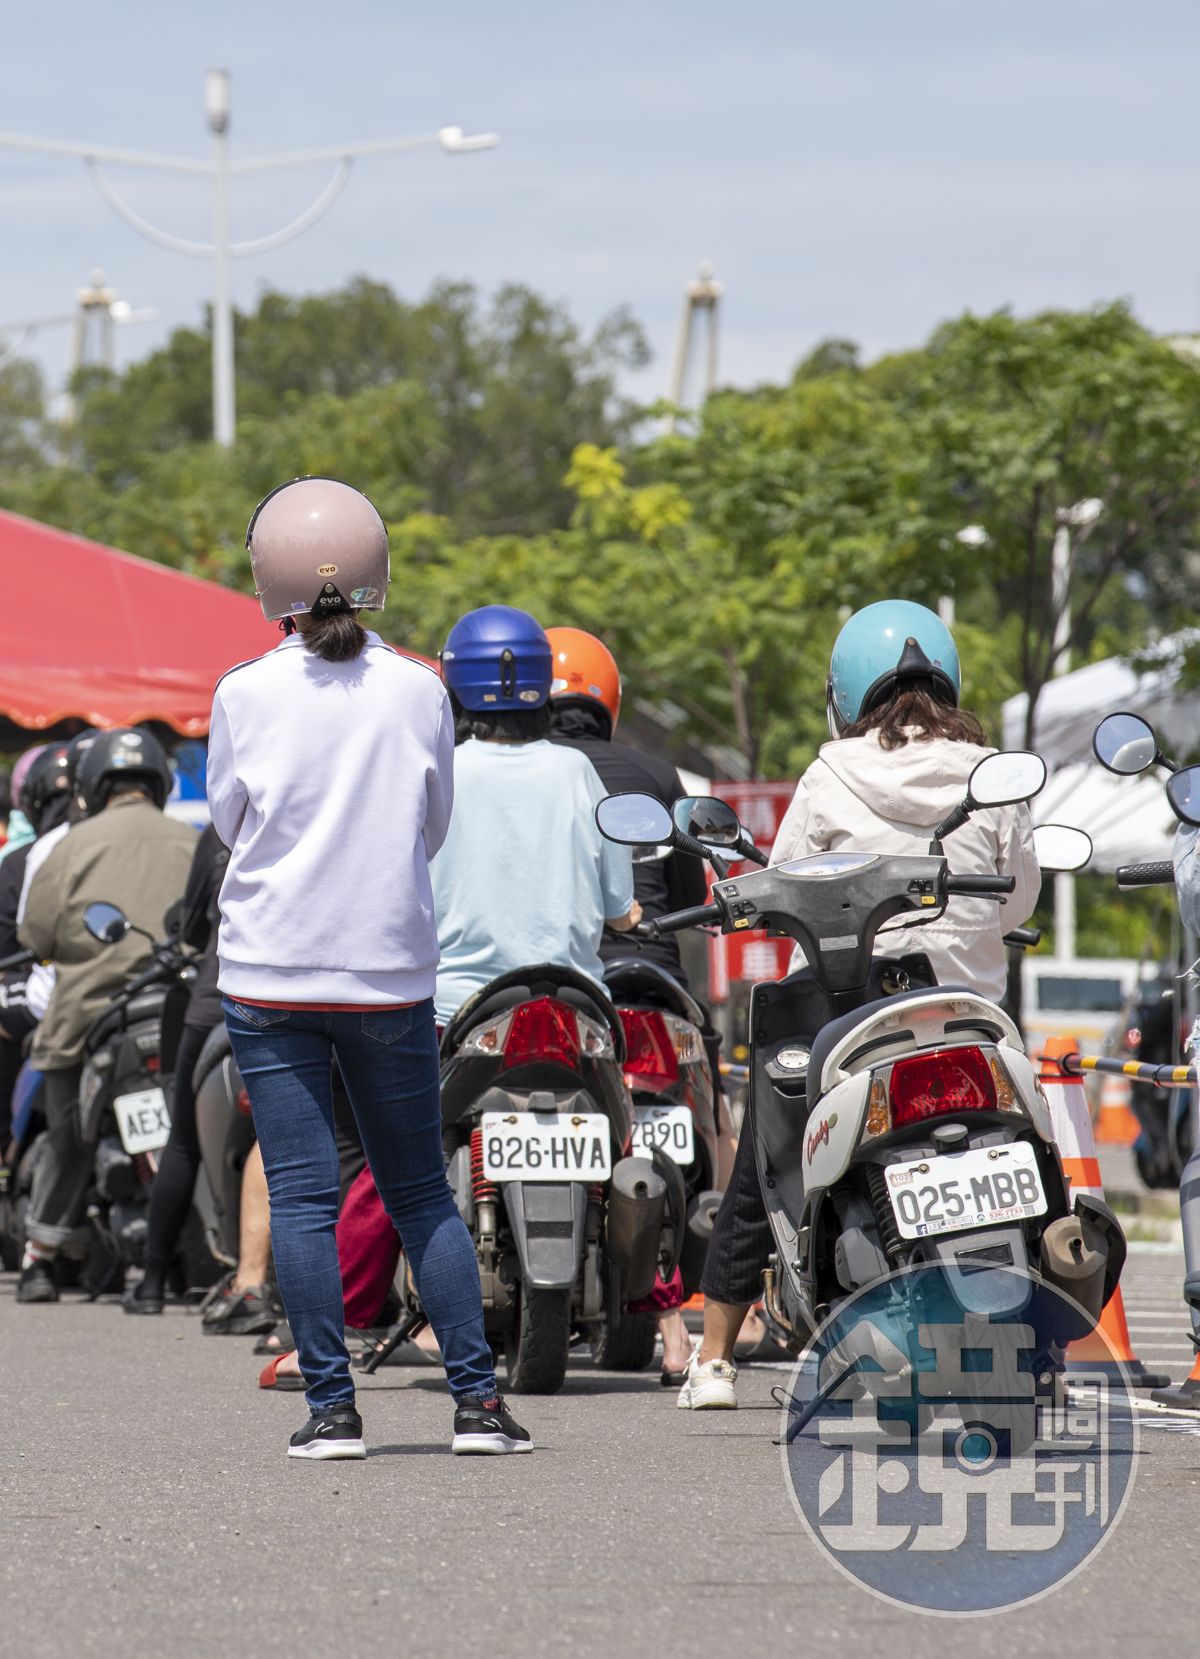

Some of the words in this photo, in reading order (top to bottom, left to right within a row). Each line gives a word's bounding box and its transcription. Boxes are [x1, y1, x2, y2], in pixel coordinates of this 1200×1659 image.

[320, 596, 341, 604] evo
[487, 1136, 606, 1169] 826-HVA
[807, 1119, 830, 1167] Candy
[896, 1167, 1040, 1225] 025-MBB
